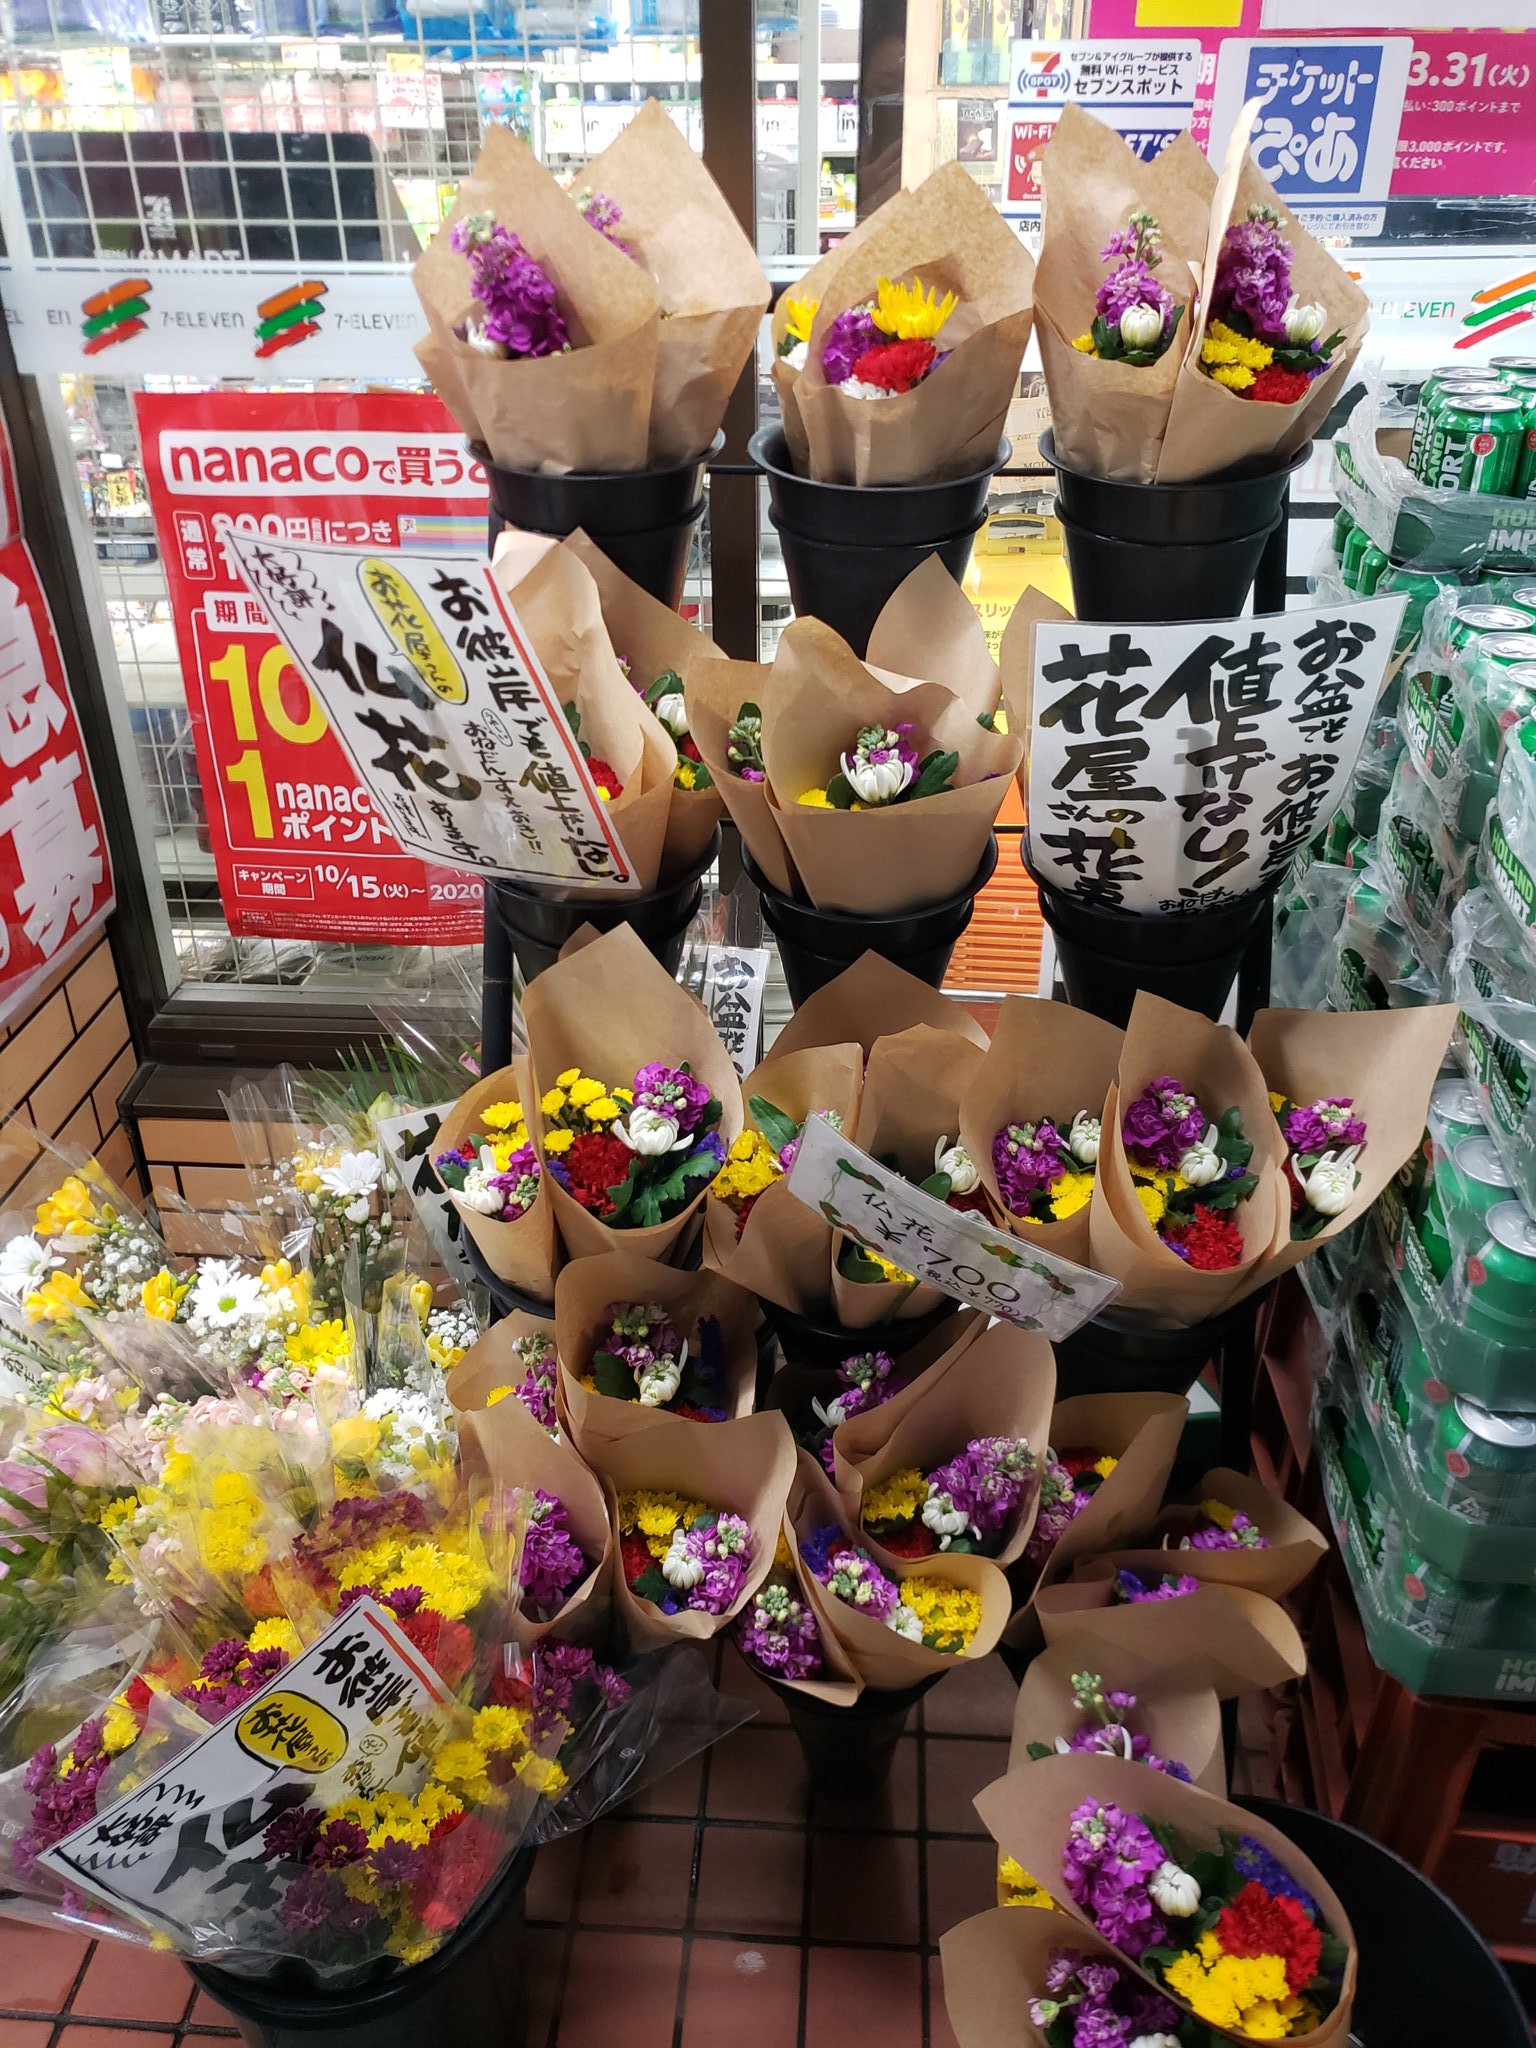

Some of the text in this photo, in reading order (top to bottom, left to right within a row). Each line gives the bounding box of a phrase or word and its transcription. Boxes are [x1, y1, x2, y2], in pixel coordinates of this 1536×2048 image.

[1080, 65, 1179, 76] 無料 Wi-Fi サービス
[1029, 75, 1060, 87] SPOT
[1074, 79, 1183, 96] セブンスポット
[1255, 59, 1374, 107] チケット
[1014, 123, 1053, 140] Wi-Fi
[180, 519, 209, 572] 通常
[973, 602, 1016, 618] スリッ
[226, 749, 275, 839] 1
[238, 869, 307, 885] キャンペーン
[261, 882, 287, 897] 期間
